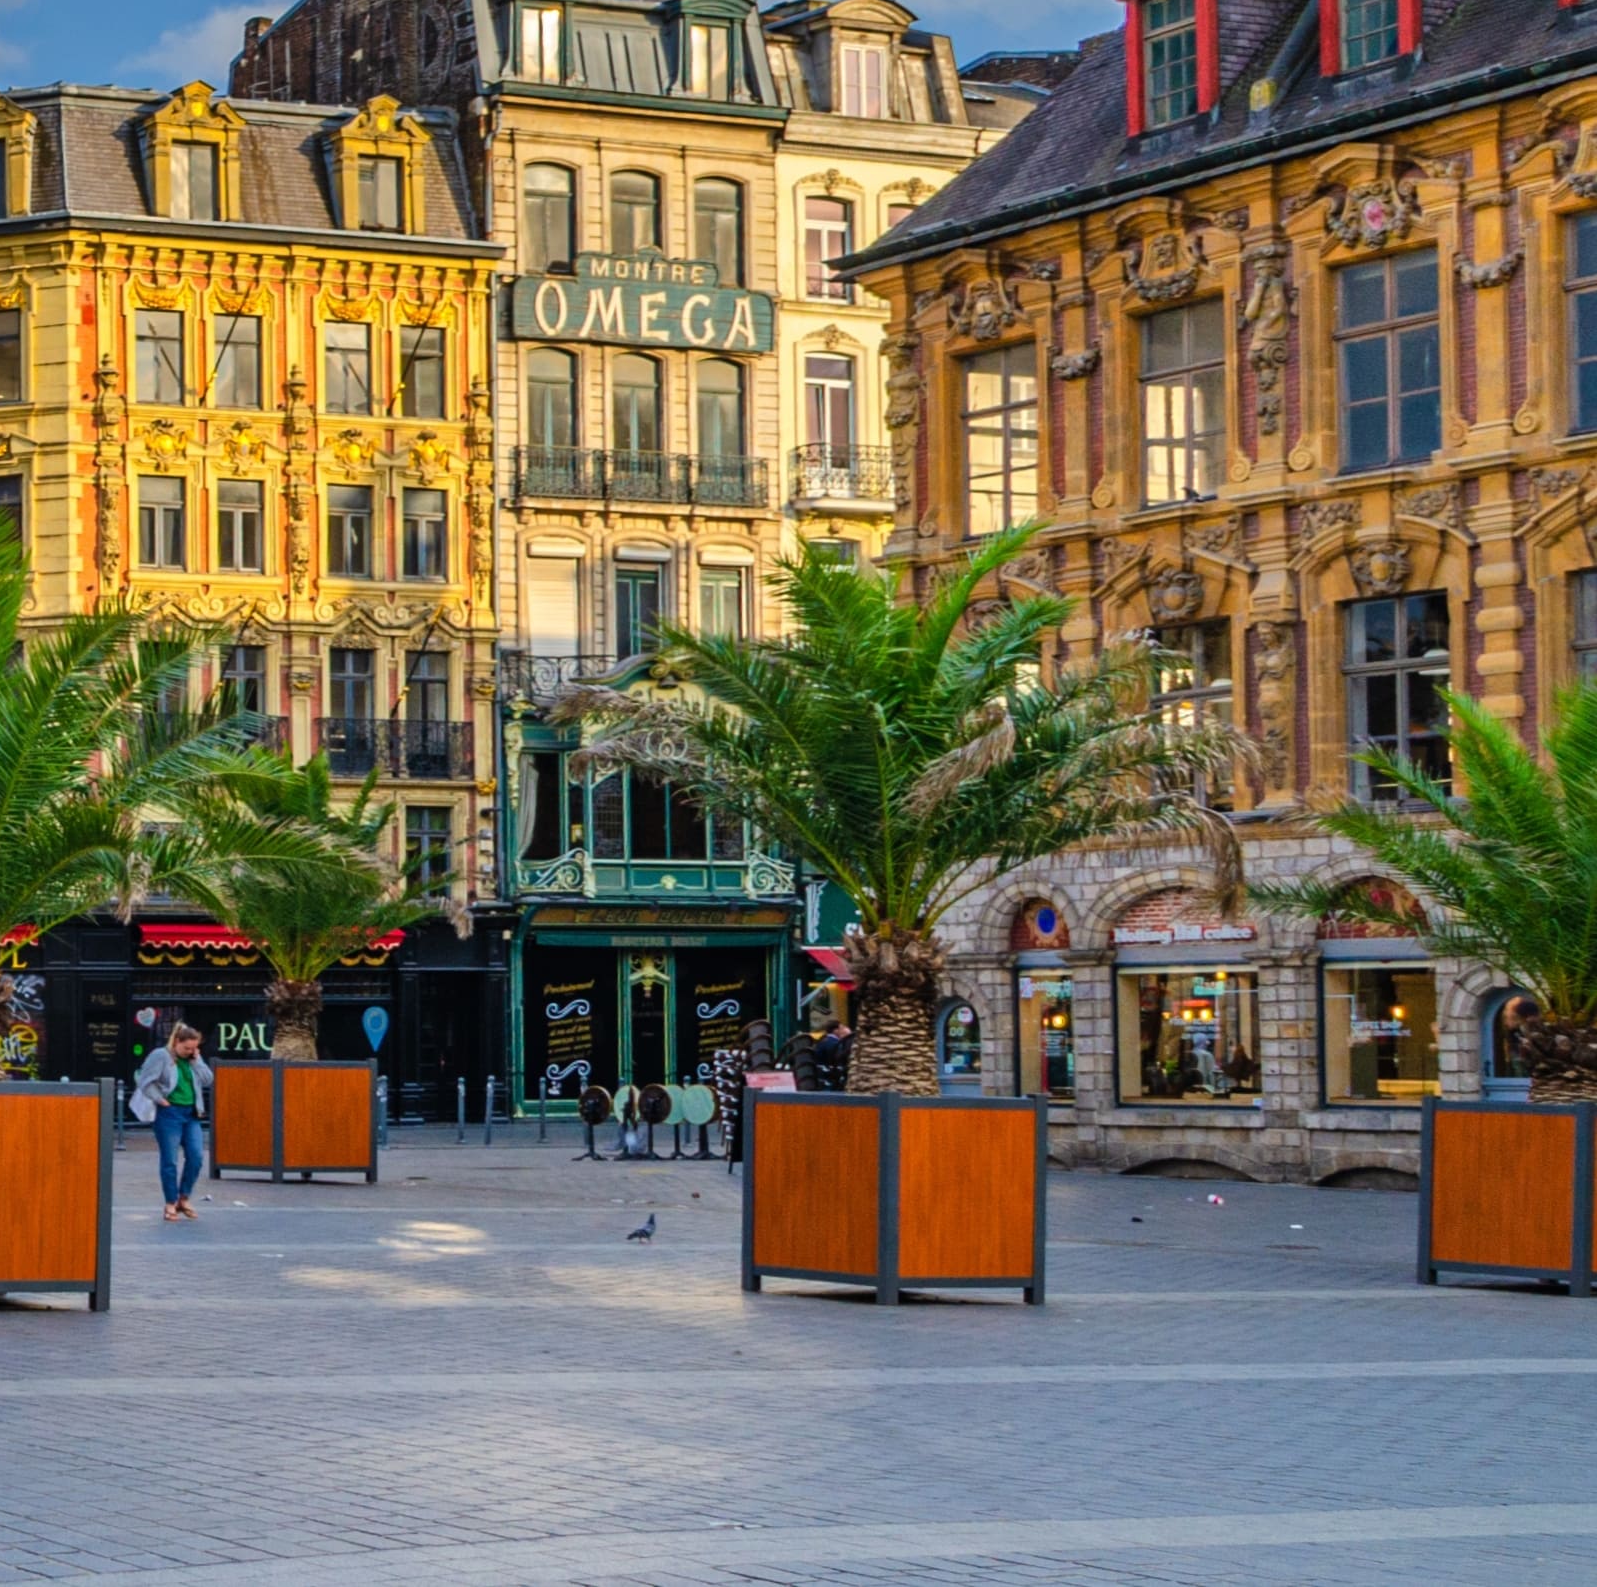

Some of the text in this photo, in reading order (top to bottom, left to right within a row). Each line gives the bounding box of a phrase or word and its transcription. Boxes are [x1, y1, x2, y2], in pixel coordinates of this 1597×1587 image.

[591, 258, 705, 284] MONTRE
[534, 280, 757, 348] OMEGA
[216, 1022, 275, 1052] PAU
